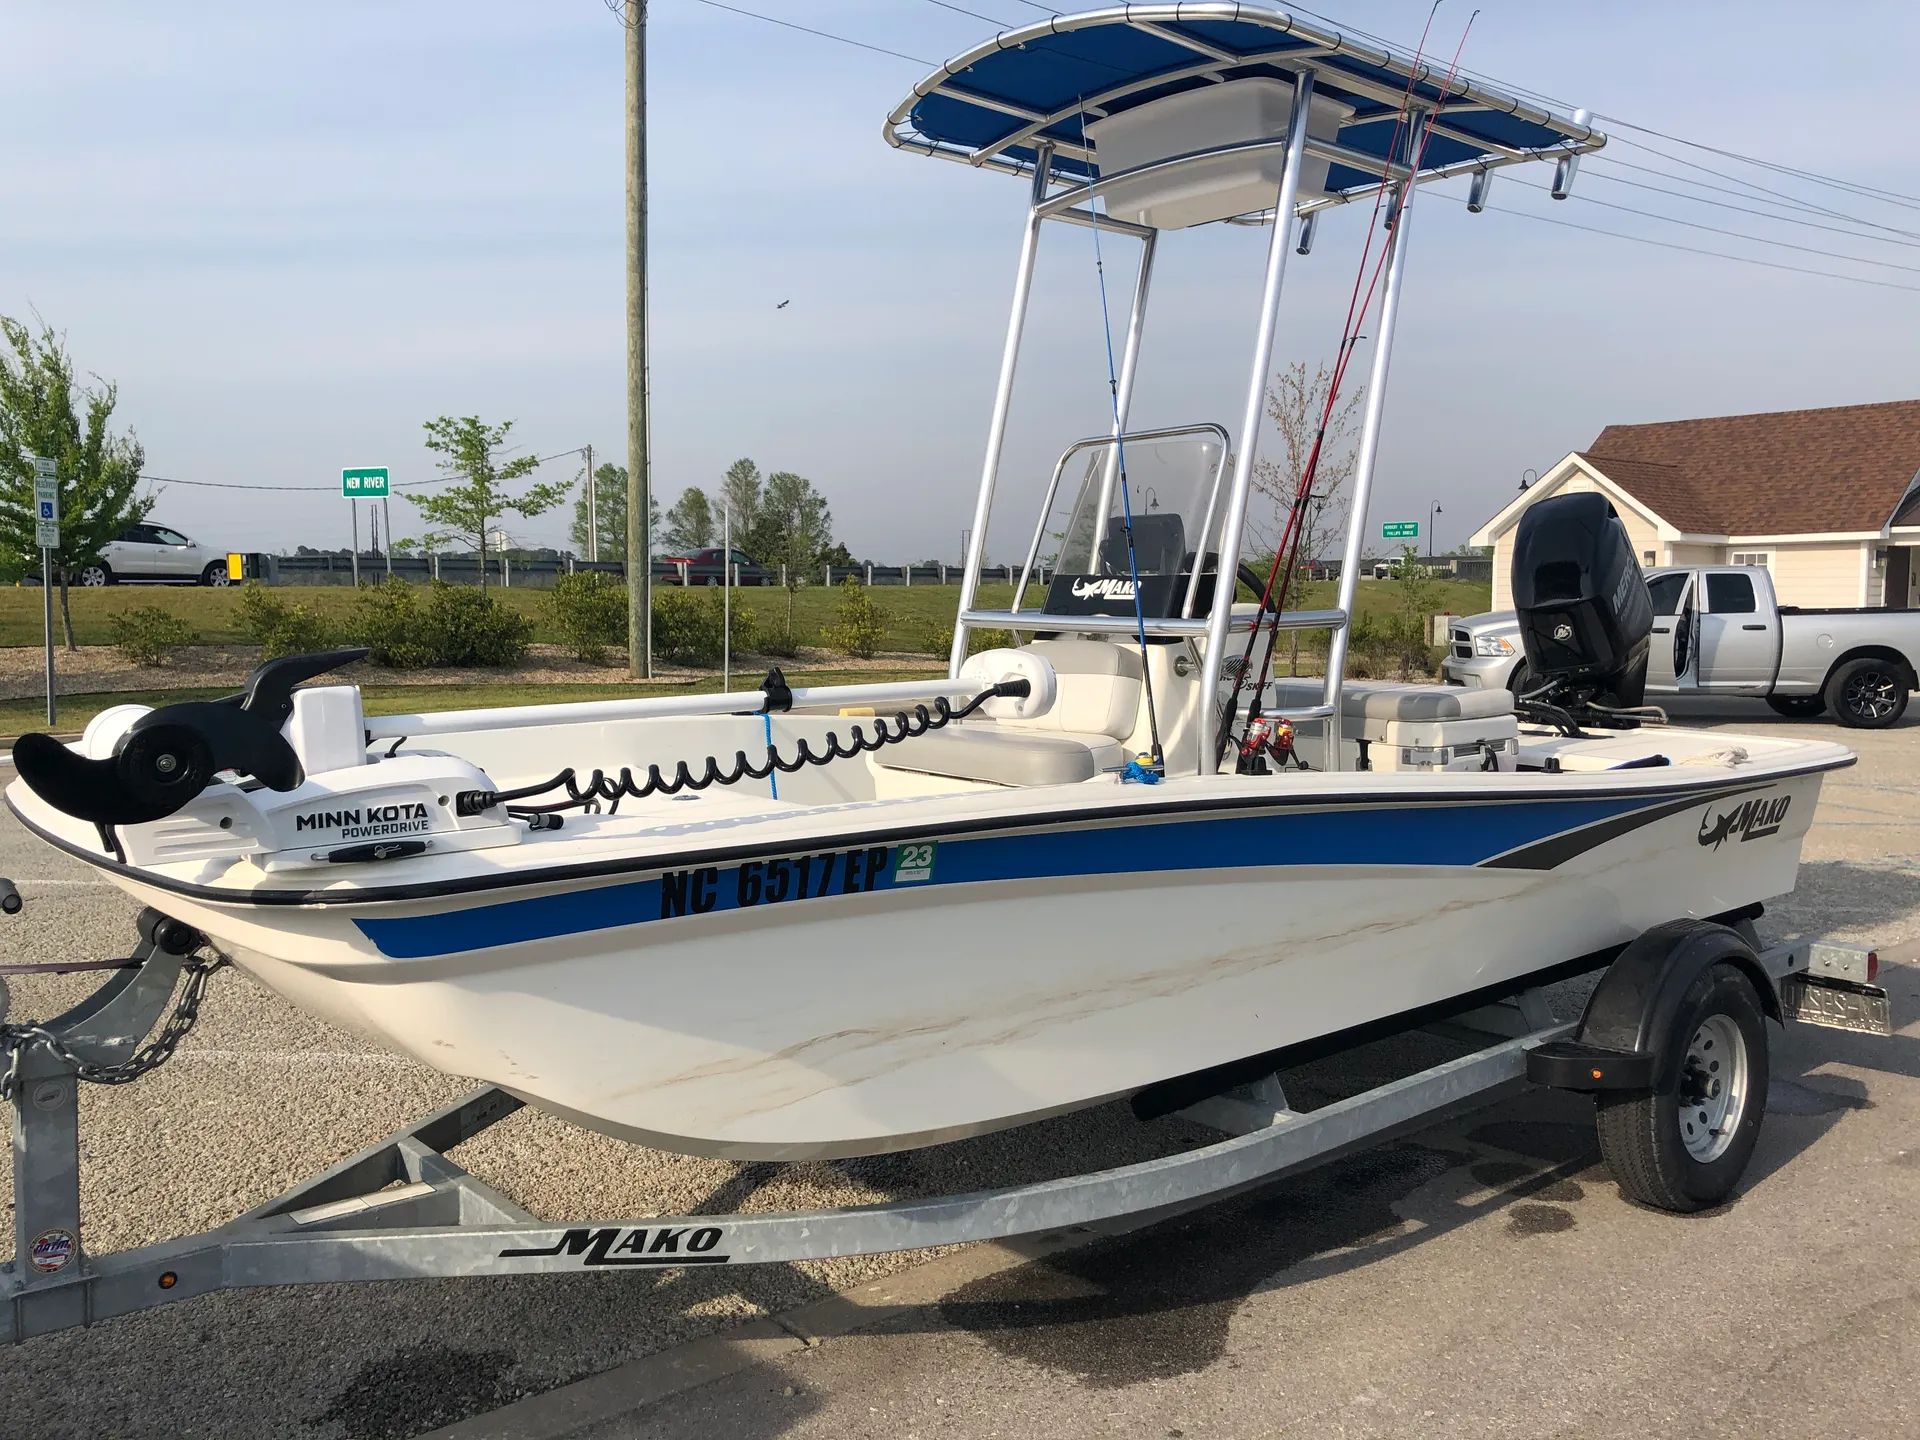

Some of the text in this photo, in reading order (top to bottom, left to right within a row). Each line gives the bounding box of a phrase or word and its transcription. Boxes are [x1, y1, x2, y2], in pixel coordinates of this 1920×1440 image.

[35, 480, 56, 490] RESERVED
[346, 476, 385, 489] NEW RIVER
[38, 491, 55, 500] PARKING
[1612, 552, 1635, 615] MERC
[1246, 681, 1273, 691] SKFF
[296, 803, 428, 831] MINN KOTA
[1729, 795, 1791, 842] MAKO
[342, 820, 429, 839] POWERDRIVE
[900, 845, 933, 868] 23
[661, 846, 888, 919] NC 6517 EP
[498, 1228, 731, 1266] MAKO
